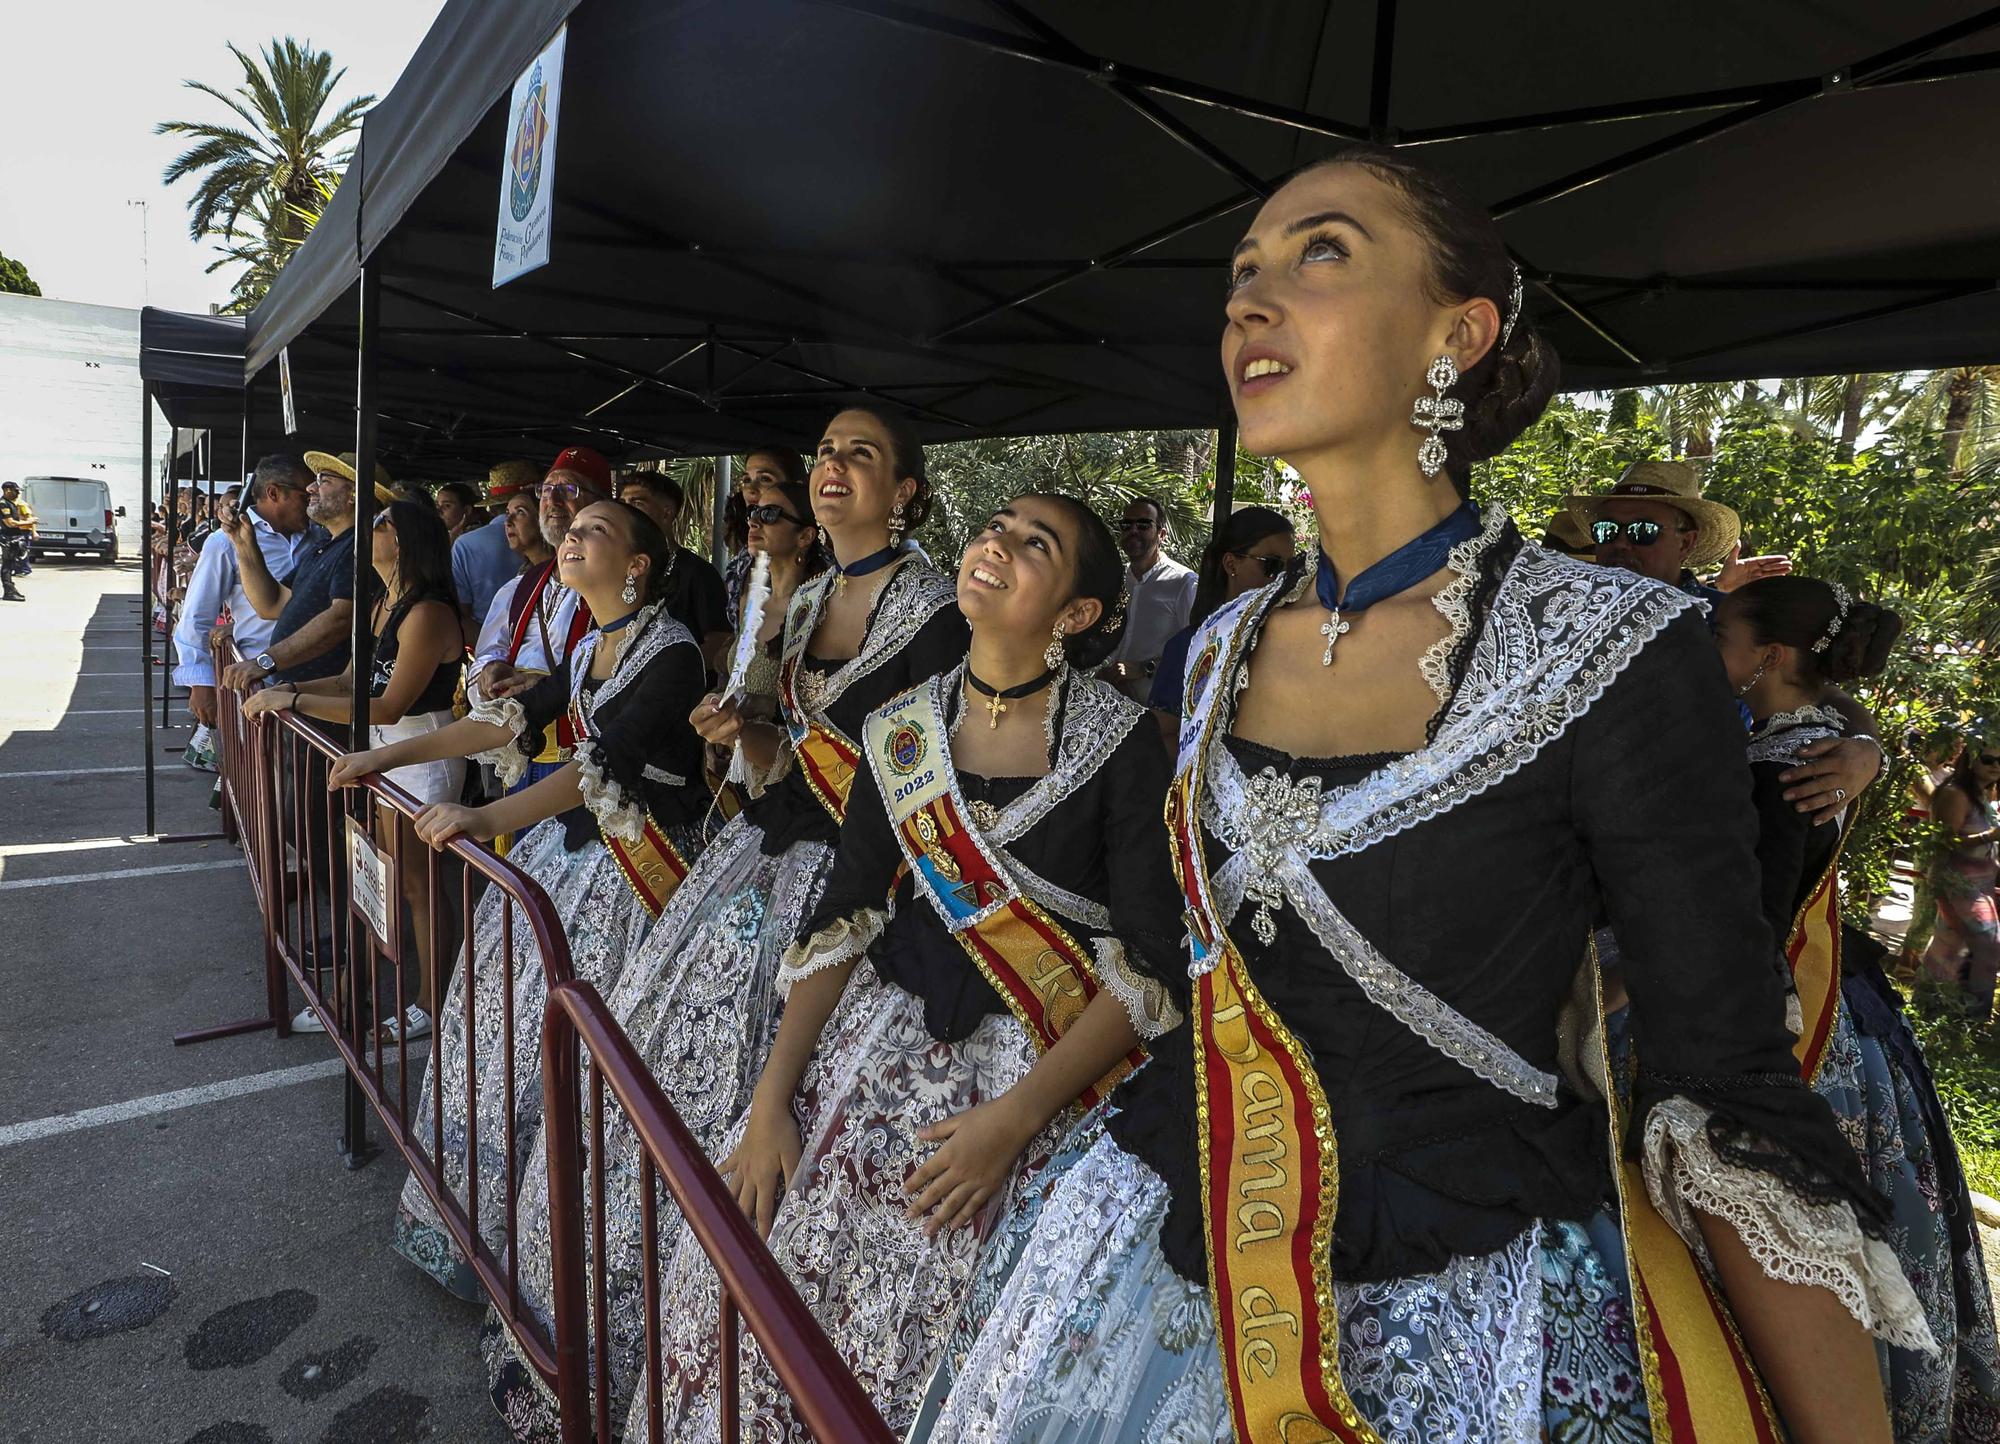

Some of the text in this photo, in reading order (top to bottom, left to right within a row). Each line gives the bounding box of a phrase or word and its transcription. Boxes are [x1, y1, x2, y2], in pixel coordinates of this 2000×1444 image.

[879, 695, 918, 719] Elche
[894, 770, 935, 803] 2022
[1211, 988, 1300, 1385] Dama de
